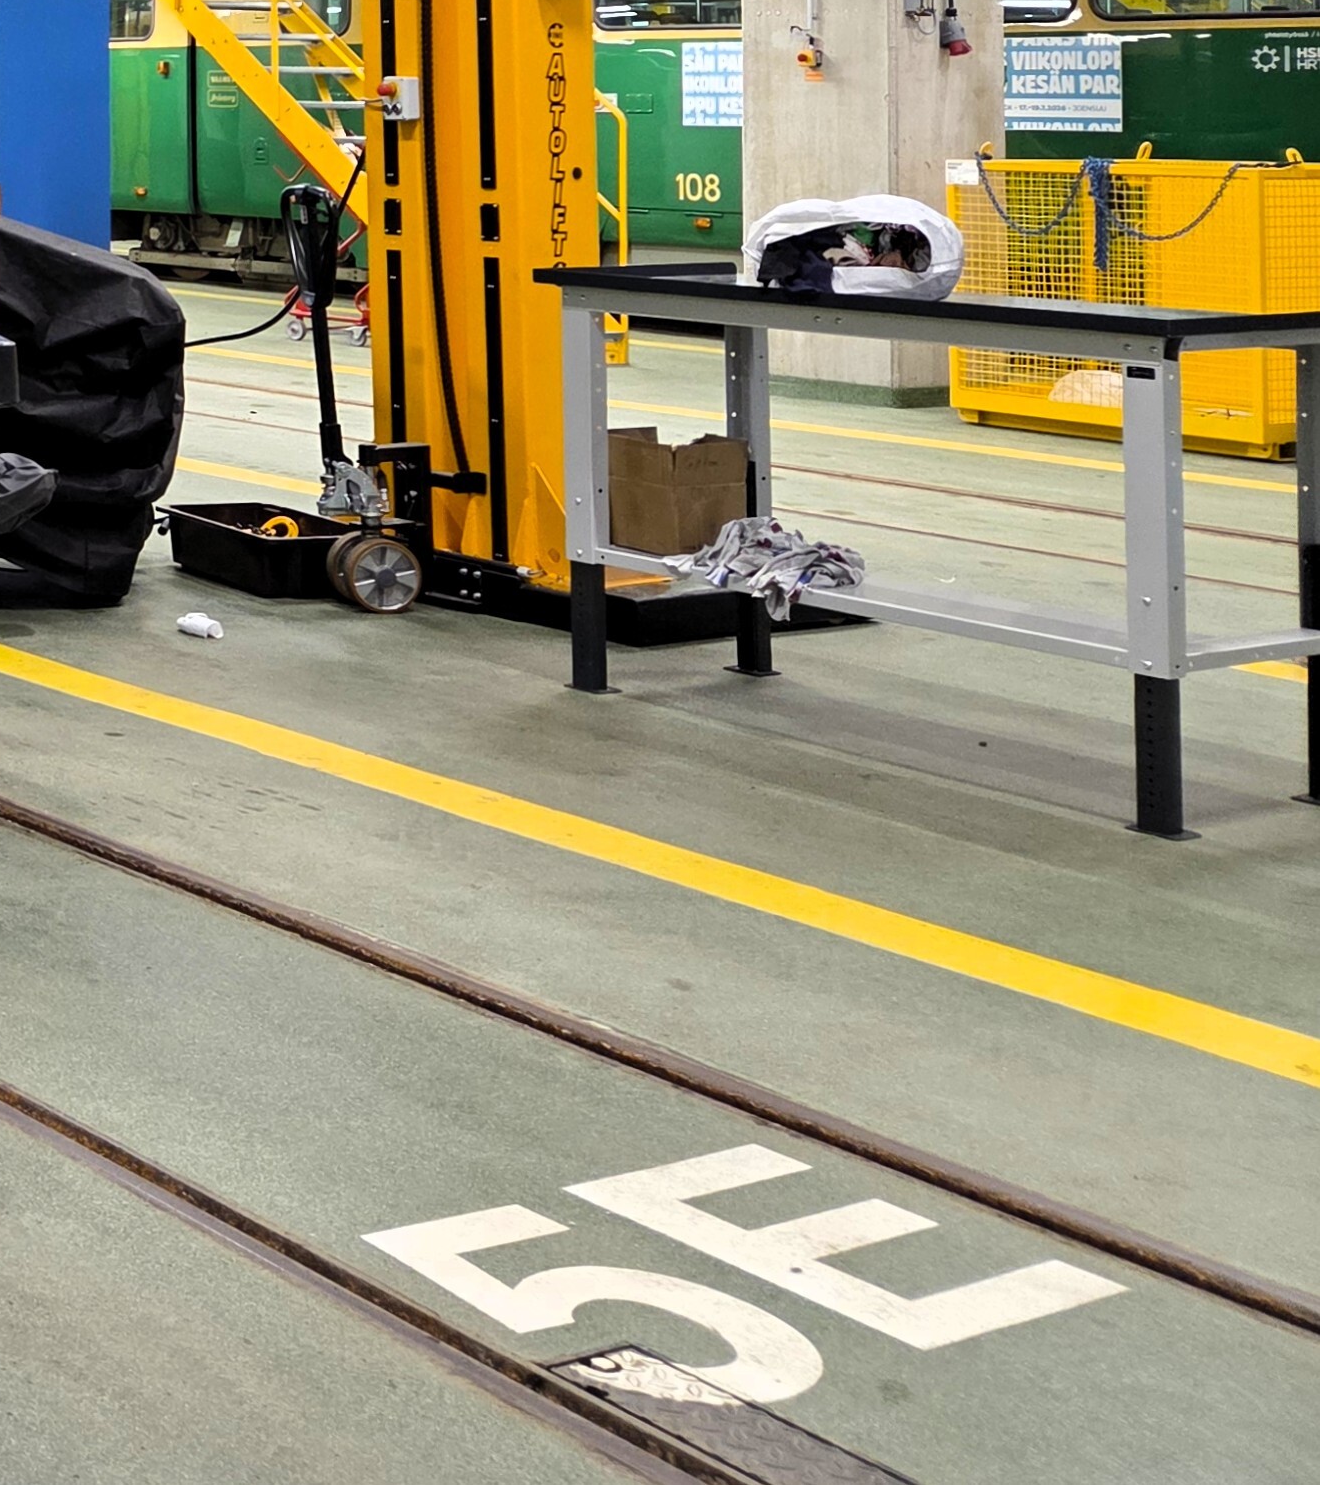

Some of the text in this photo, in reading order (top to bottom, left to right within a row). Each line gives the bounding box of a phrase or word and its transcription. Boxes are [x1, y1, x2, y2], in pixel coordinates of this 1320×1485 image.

[1296, 59, 1320, 70] HR
[1011, 70, 1075, 94] KESÄN
[546, 53, 567, 268] AUTOLIFT
[676, 173, 721, 202] 108
[361, 1143, 1130, 1407] 5E
